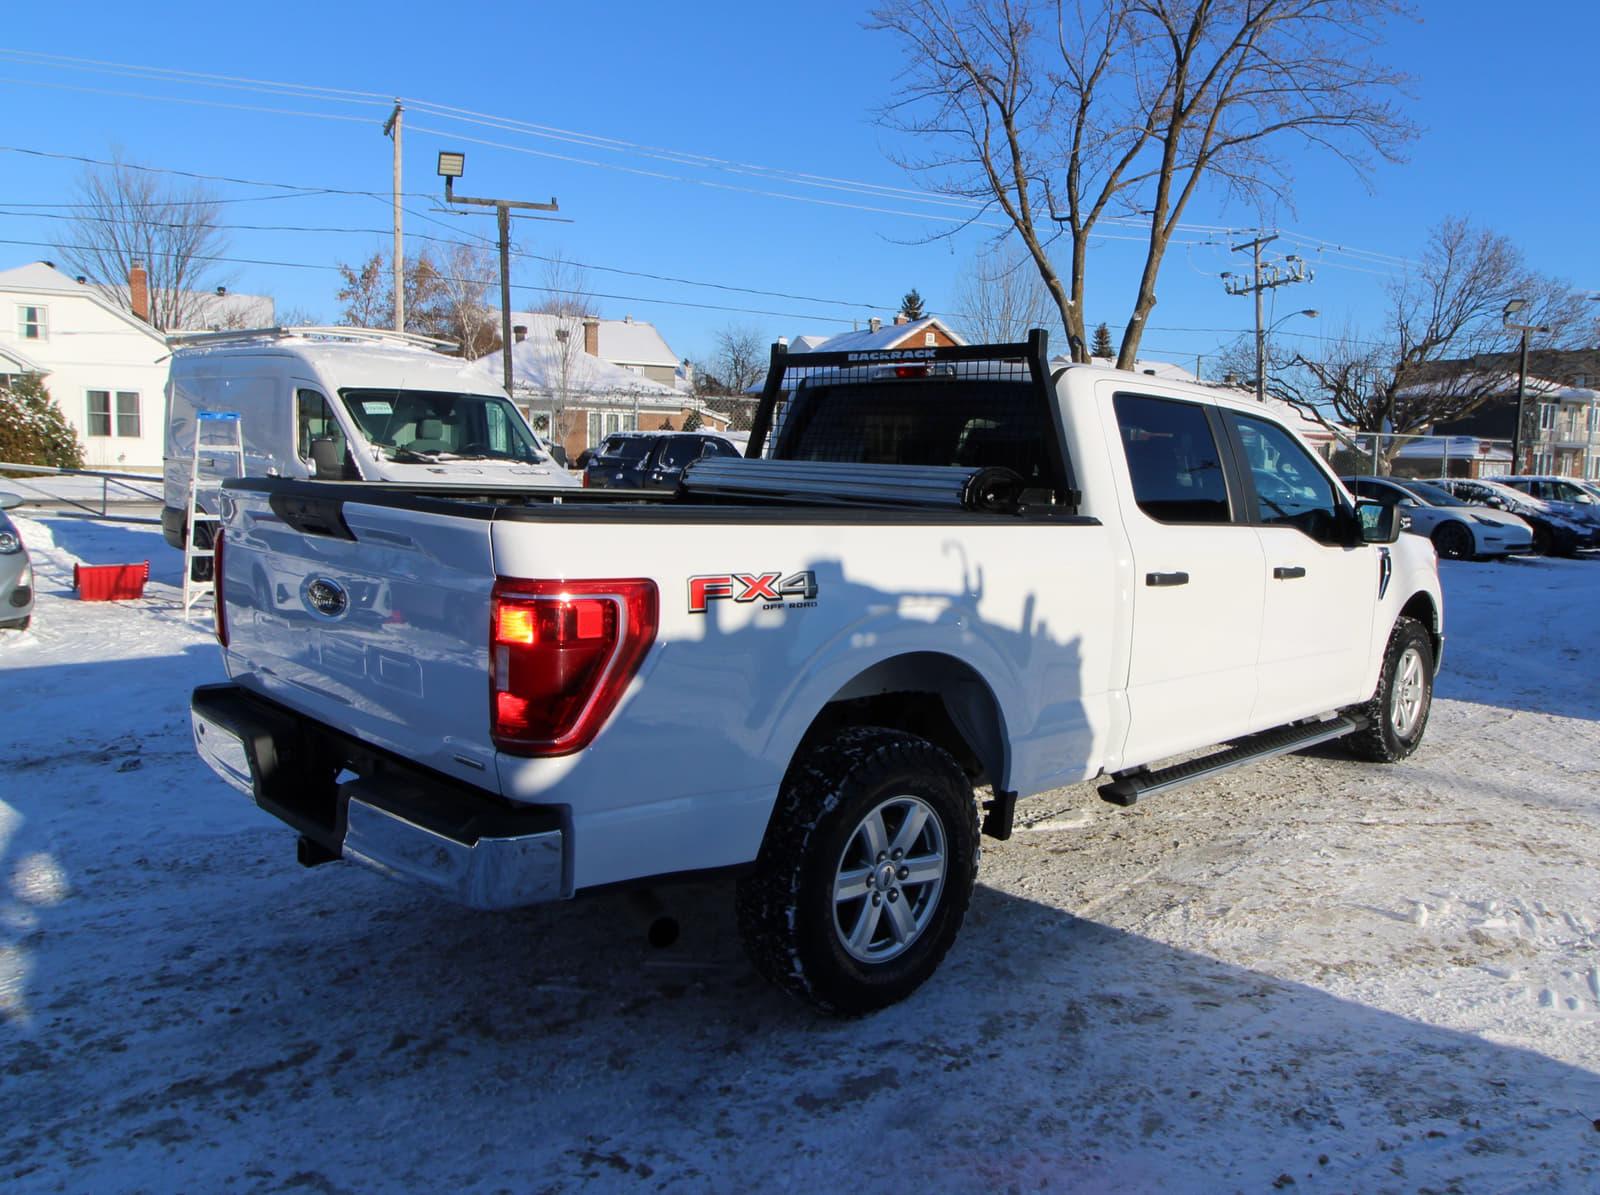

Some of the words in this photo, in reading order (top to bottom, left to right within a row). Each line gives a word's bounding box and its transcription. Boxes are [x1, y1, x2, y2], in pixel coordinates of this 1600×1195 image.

[847, 350, 936, 362] BACKRACK
[687, 570, 819, 614] FX4
[788, 601, 818, 609] ROAD
